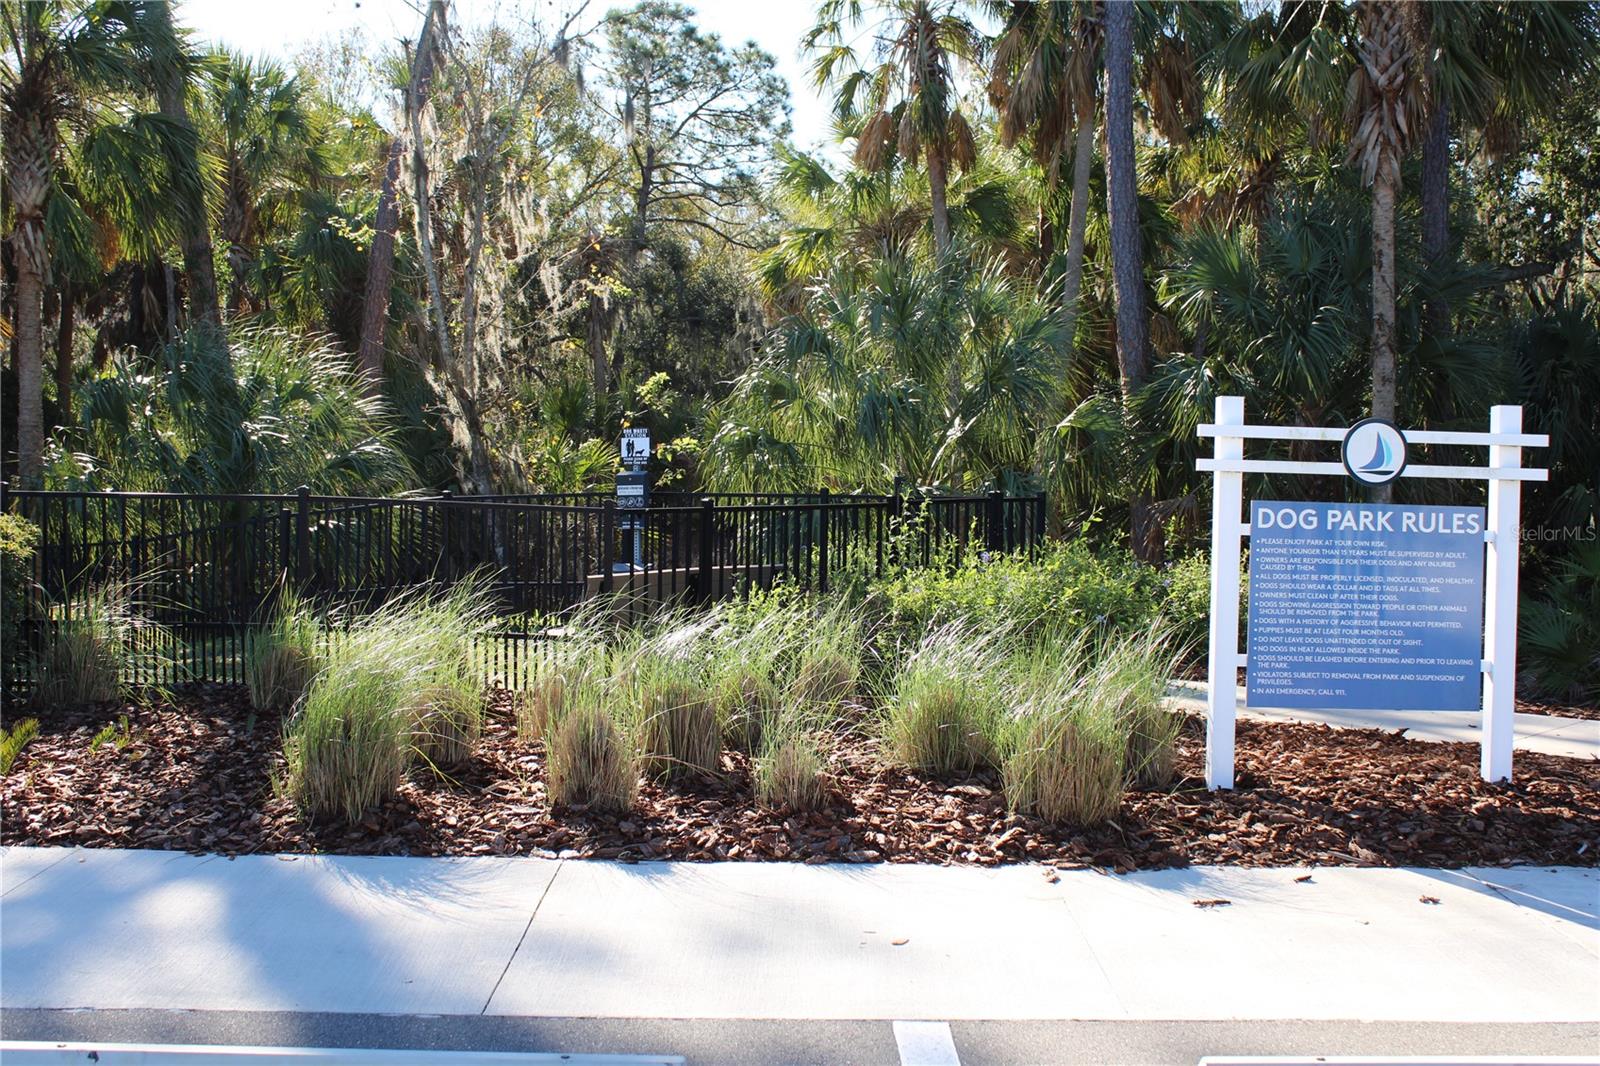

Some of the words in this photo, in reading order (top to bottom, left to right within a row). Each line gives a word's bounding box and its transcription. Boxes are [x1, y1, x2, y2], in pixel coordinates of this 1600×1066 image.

[1257, 508, 1318, 530] DOG
[1327, 510, 1394, 533] PARK
[1402, 512, 1480, 535] RULES
